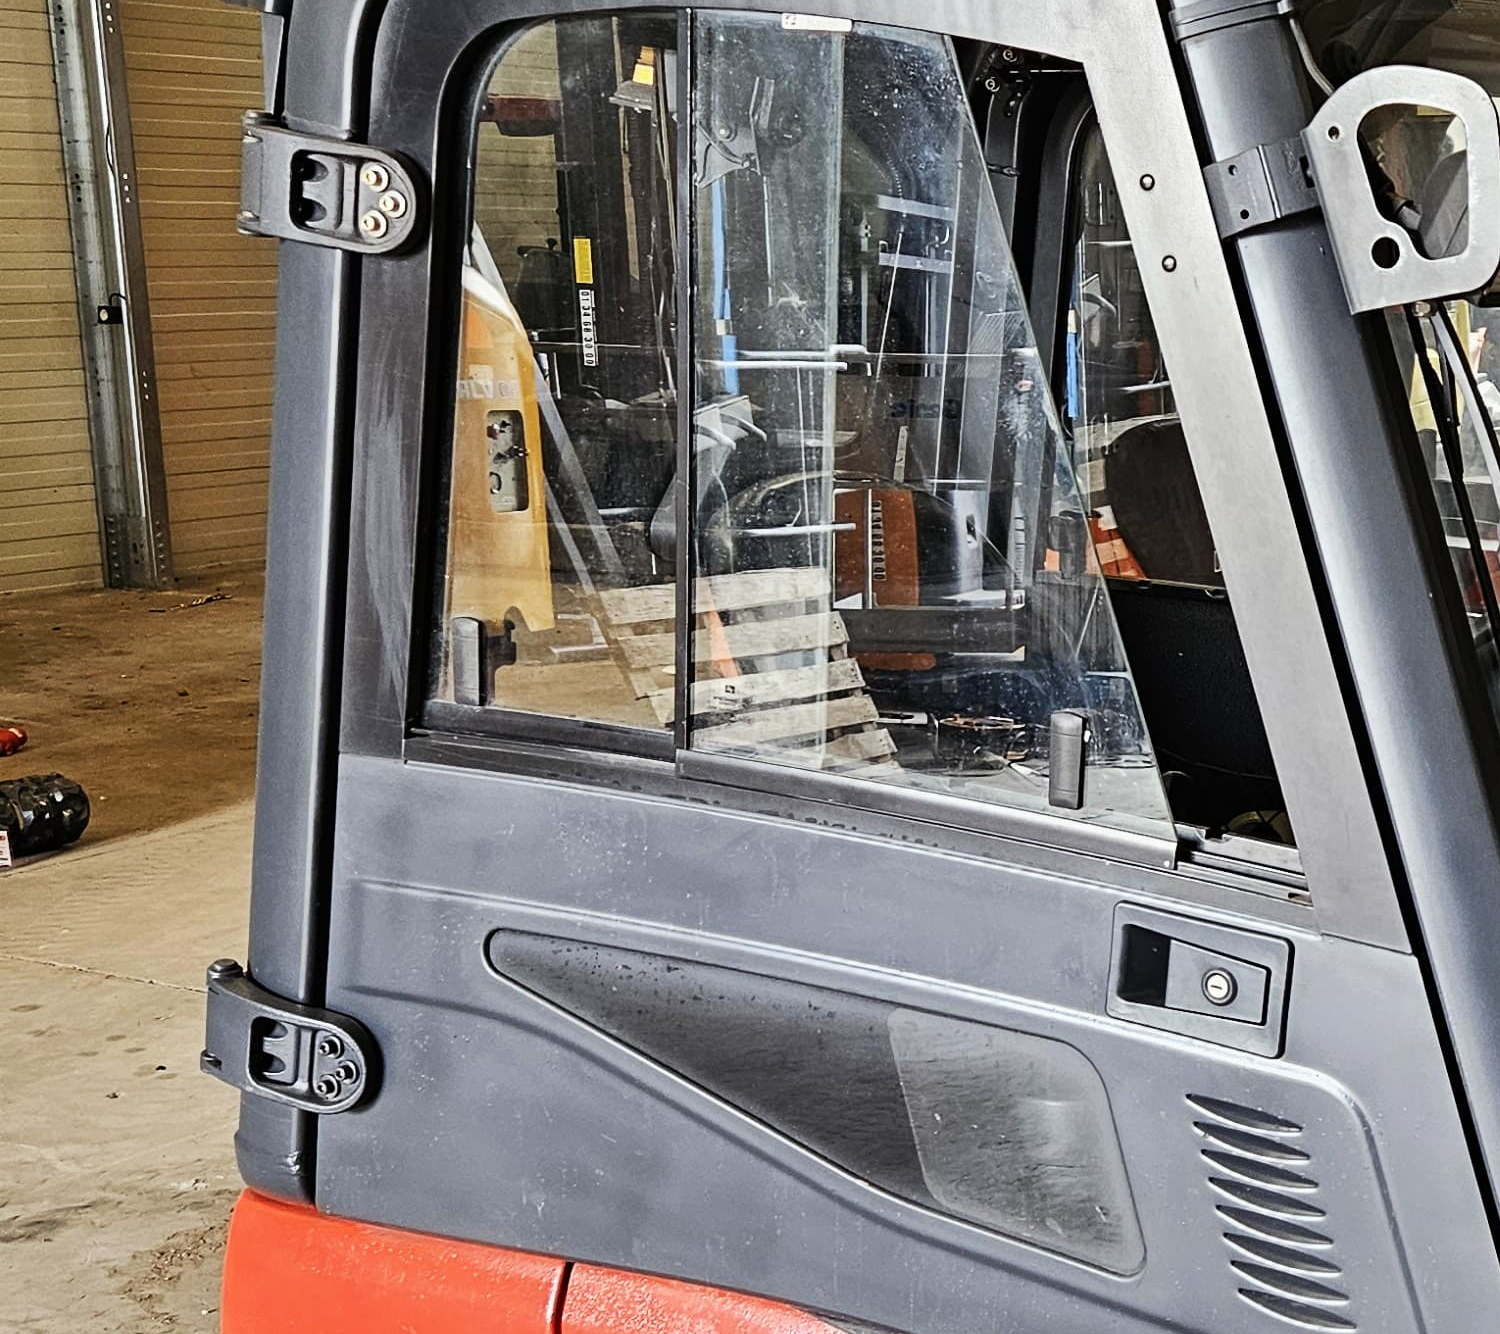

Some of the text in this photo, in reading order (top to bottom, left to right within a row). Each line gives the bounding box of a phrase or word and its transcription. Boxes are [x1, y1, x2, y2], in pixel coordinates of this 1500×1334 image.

[580, 291, 590, 301] 01
[581, 305, 591, 317] 34
[583, 321, 593, 333] 68
[585, 352, 595, 365] 00
